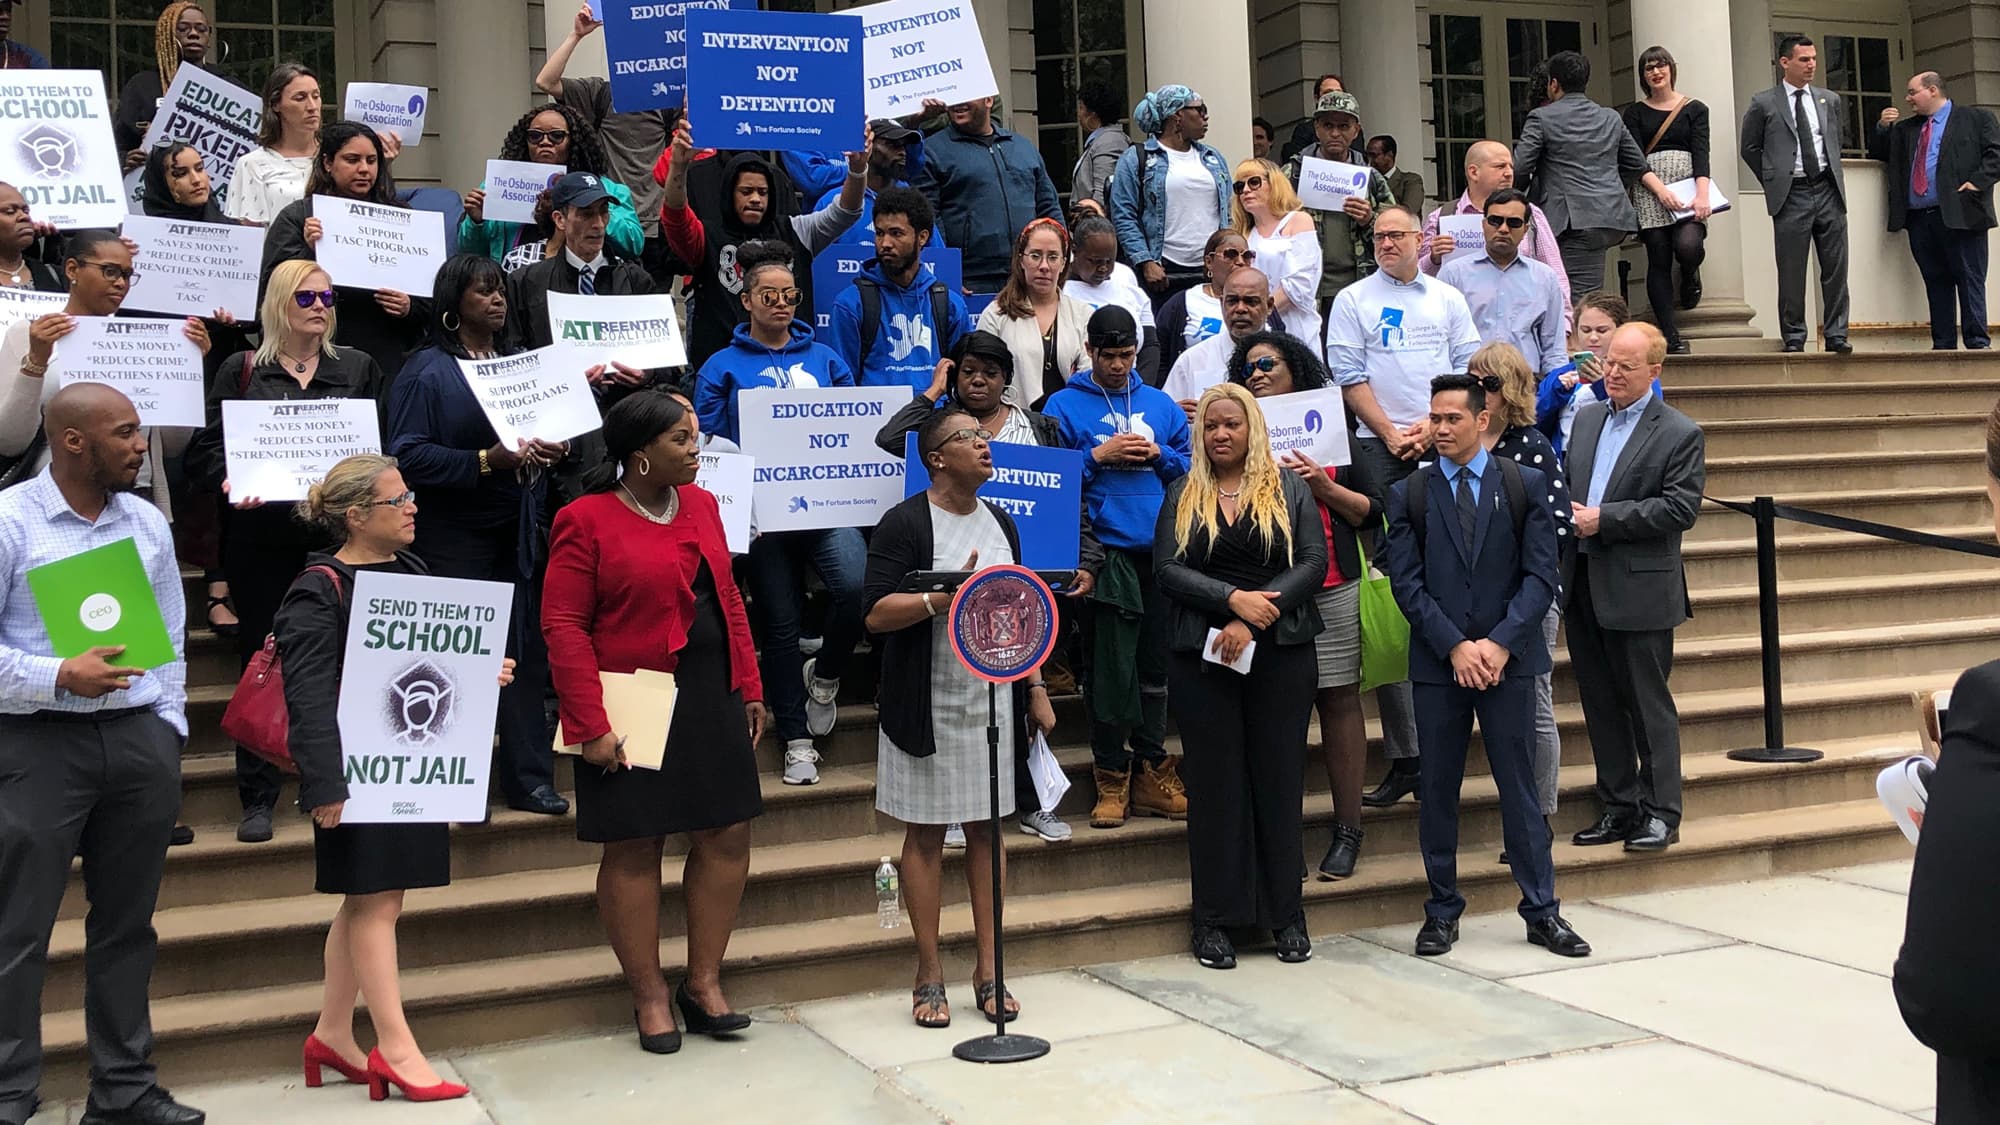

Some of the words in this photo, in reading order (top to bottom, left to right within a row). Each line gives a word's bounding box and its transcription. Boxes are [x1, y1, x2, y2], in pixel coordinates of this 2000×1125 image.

[862, 7, 961, 39] TERVENTION
[665, 30, 686, 44] NO
[702, 32, 850, 53] INTERVENTION
[890, 40, 926, 58] NOT
[756, 65, 799, 82] NOT
[868, 58, 963, 90] DETENTION
[27, 86, 71, 97] THEM
[73, 86, 93, 97] TO
[913, 89, 935, 98] Fortune
[936, 84, 957, 93] Society
[181, 79, 263, 130] EDUCAT
[353, 99, 368, 110] The
[368, 99, 406, 114] Osborne
[720, 95, 836, 114] DETENTION
[362, 111, 412, 127] Association
[163, 112, 250, 163] RIKER
[754, 125, 768, 133] The
[768, 126, 796, 134] Fortune
[796, 126, 822, 136] Society
[493, 176, 507, 187] The
[508, 177, 545, 191] Osborne
[1307, 169, 1319, 180] The
[1319, 171, 1350, 185] Osborne
[17, 186, 54, 205] OT
[57, 185, 116, 205] JAIL
[501, 189, 539, 203] Associa
[1312, 181, 1355, 196] Association
[358, 225, 405, 241] SUPPORT
[333, 234, 364, 247] TASC
[366, 239, 429, 257] PROGRAMS
[379, 255, 397, 265] EAC
[133, 261, 205, 276] TRENGTHENS
[207, 270, 258, 281] FAMILIES
[176, 292, 205, 303] TASC
[561, 319, 601, 342] ATI
[599, 318, 670, 333] REENTRY
[600, 327, 670, 342] COALITION
[488, 378, 538, 397] SUPPORT
[499, 383, 569, 410] PROGRAMS
[135, 400, 159, 410] ASC
[772, 401, 883, 419] EDUCATION
[514, 410, 537, 423] EAC
[809, 433, 850, 449] NOT
[1271, 436, 1314, 451] sociation
[753, 462, 905, 483] INCARCERATION
[987, 467, 1062, 489] ORTUNE
[826, 499, 852, 507] Fortune
[853, 498, 878, 506] Society
[88, 605, 113, 620] ceo
[367, 598, 417, 617] SEND
[422, 601, 470, 621] THEM
[474, 605, 496, 623] TO
[363, 618, 491, 655] SCHOOL
[344, 754, 411, 785] NOT
[411, 756, 475, 785] JAIL
